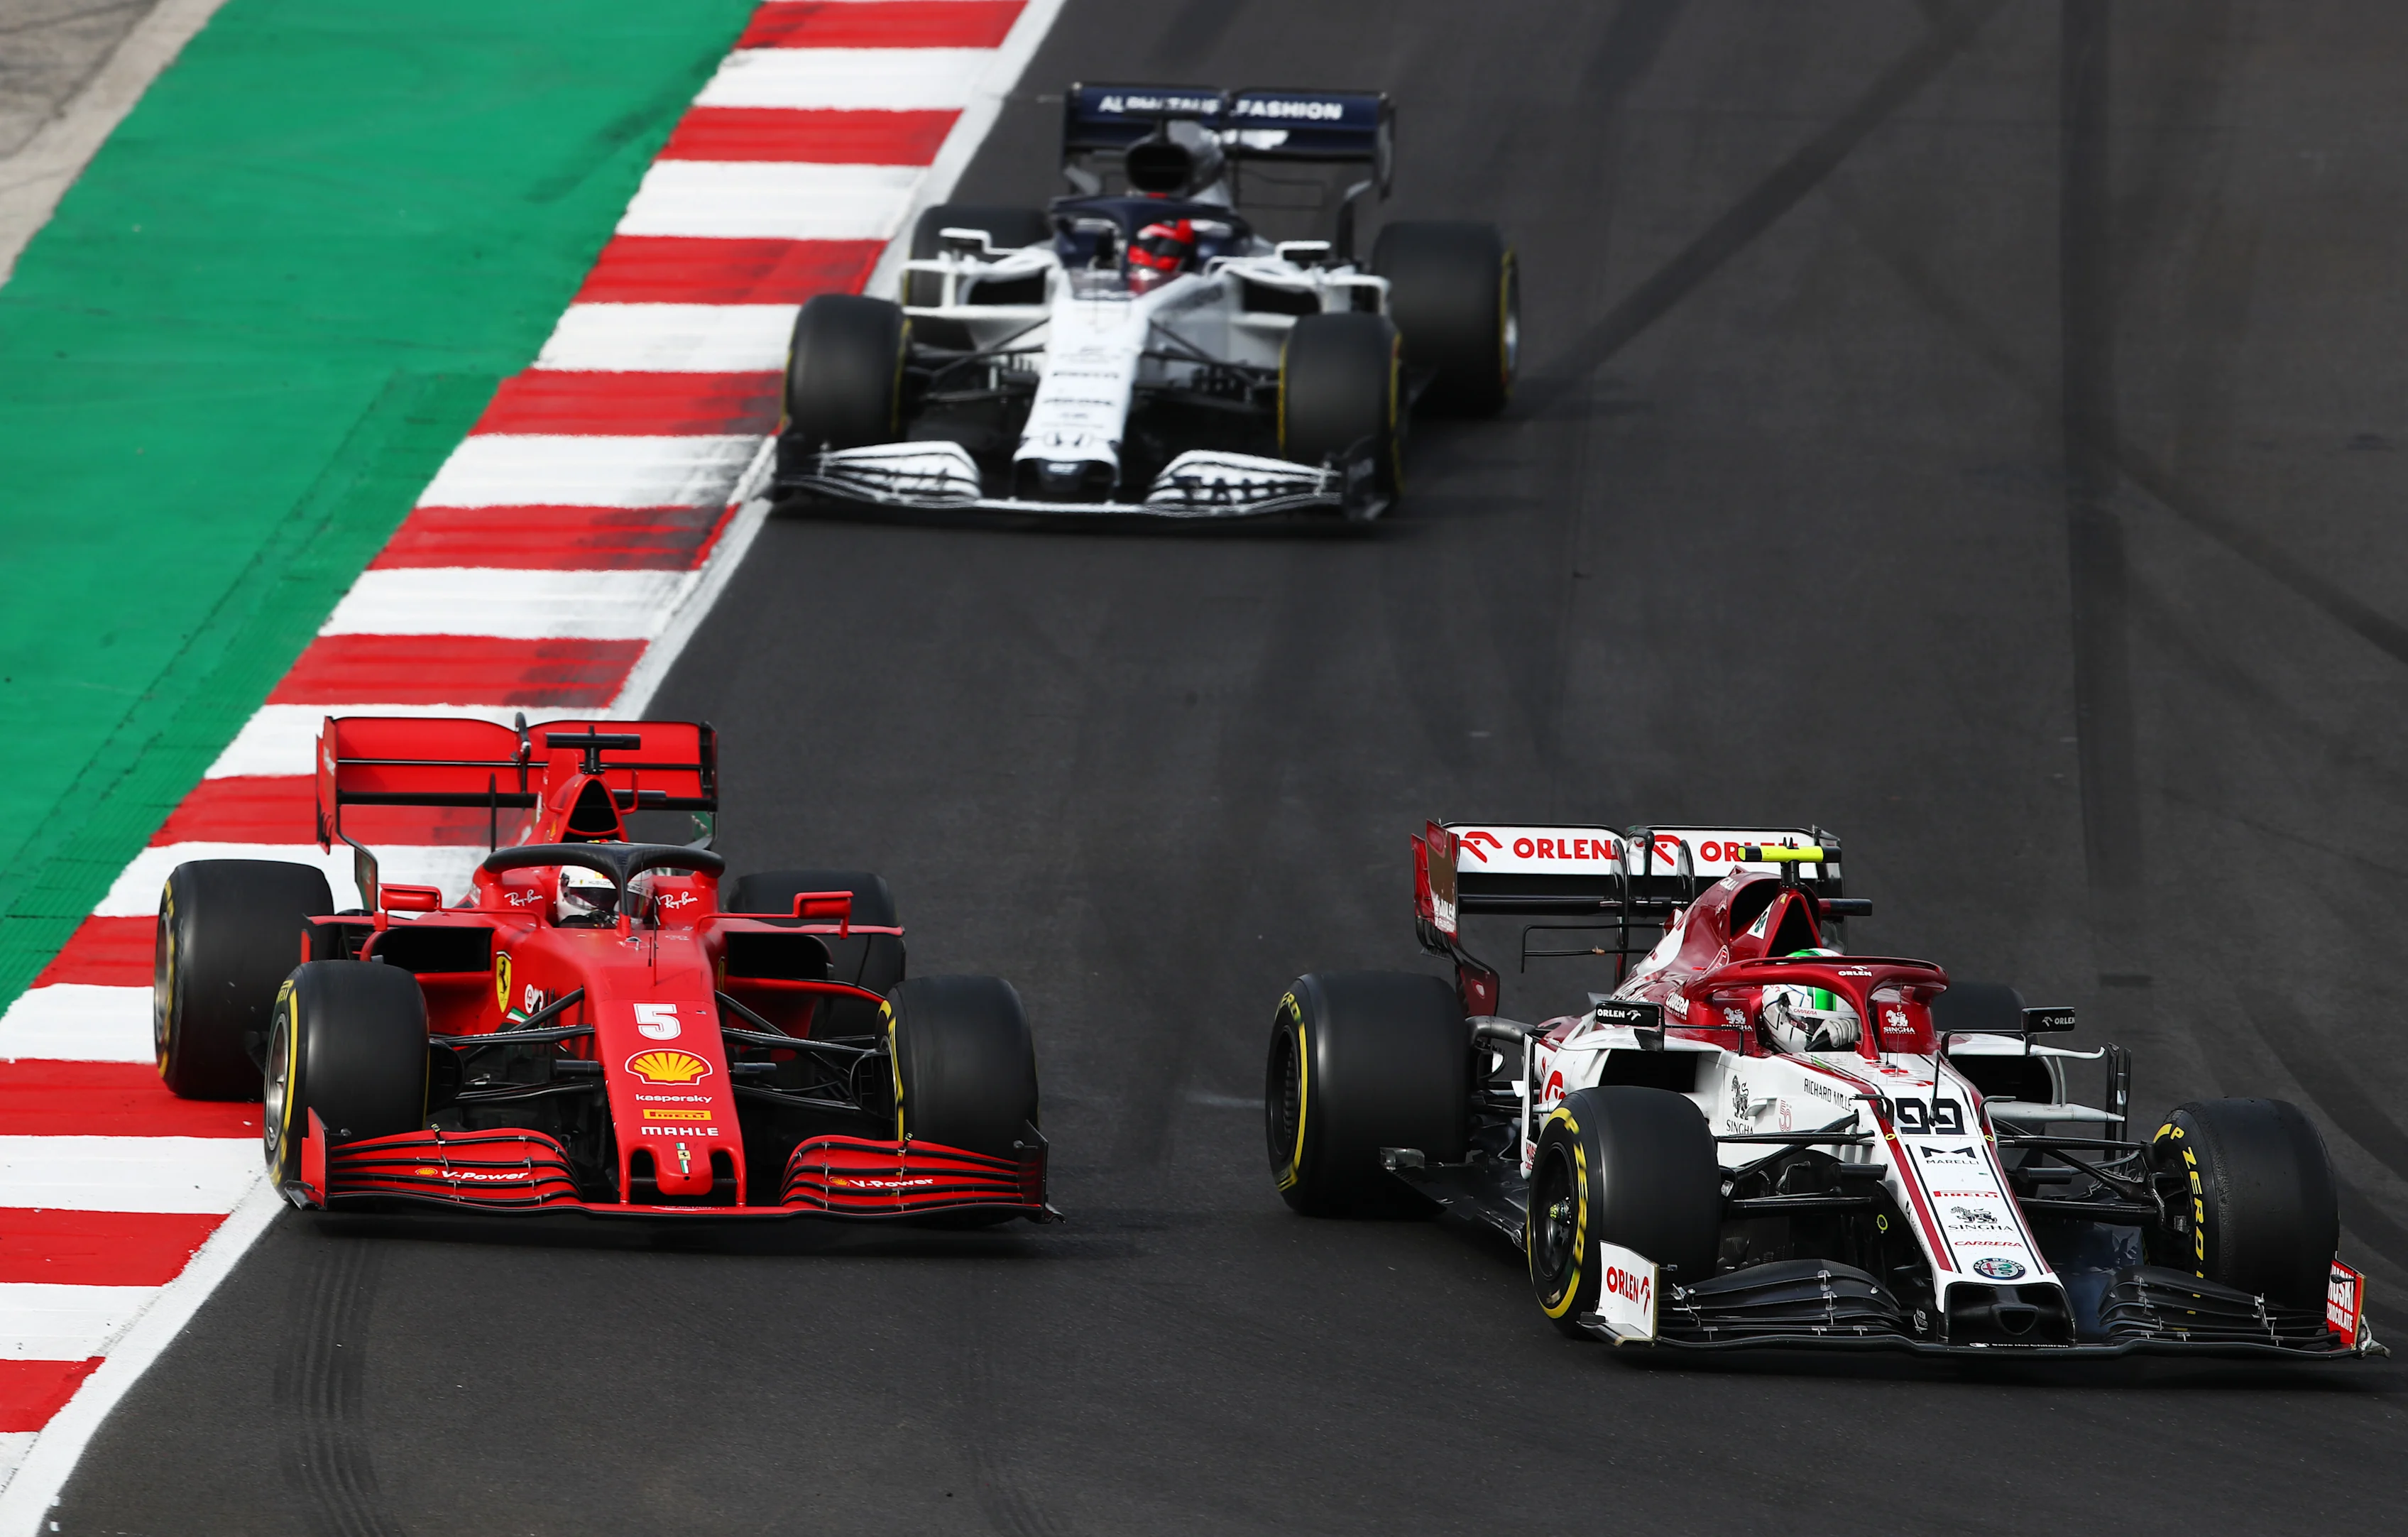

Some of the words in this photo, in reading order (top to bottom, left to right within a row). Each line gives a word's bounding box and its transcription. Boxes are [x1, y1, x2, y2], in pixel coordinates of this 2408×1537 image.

[1514, 838, 1611, 860] ORLEN
[504, 890, 543, 907] Ray-Ban
[660, 892, 698, 909] Ray-Ban
[633, 1002, 682, 1041] 5
[1597, 1008, 1626, 1019] ORLEN
[635, 1093, 713, 1104] kaspersky
[1803, 1077, 1832, 1103] RICHARD
[1832, 1090, 1852, 1112] MILLE
[1895, 1097, 1966, 1135] 99
[640, 1126, 719, 1137] MAHLE
[1726, 1118, 1755, 1135] SINGHA
[441, 1170, 529, 1181] V-Power
[849, 1178, 934, 1188] V-Power
[1932, 1190, 1999, 1198] PIRELLI
[2169, 1126, 2185, 1140] P
[2182, 1146, 2204, 1262] ZERO
[1607, 1266, 1640, 1305] ORLEN
[2328, 1264, 2355, 1313] HUSKI
[2326, 1301, 2353, 1333] CHOCOLATE
